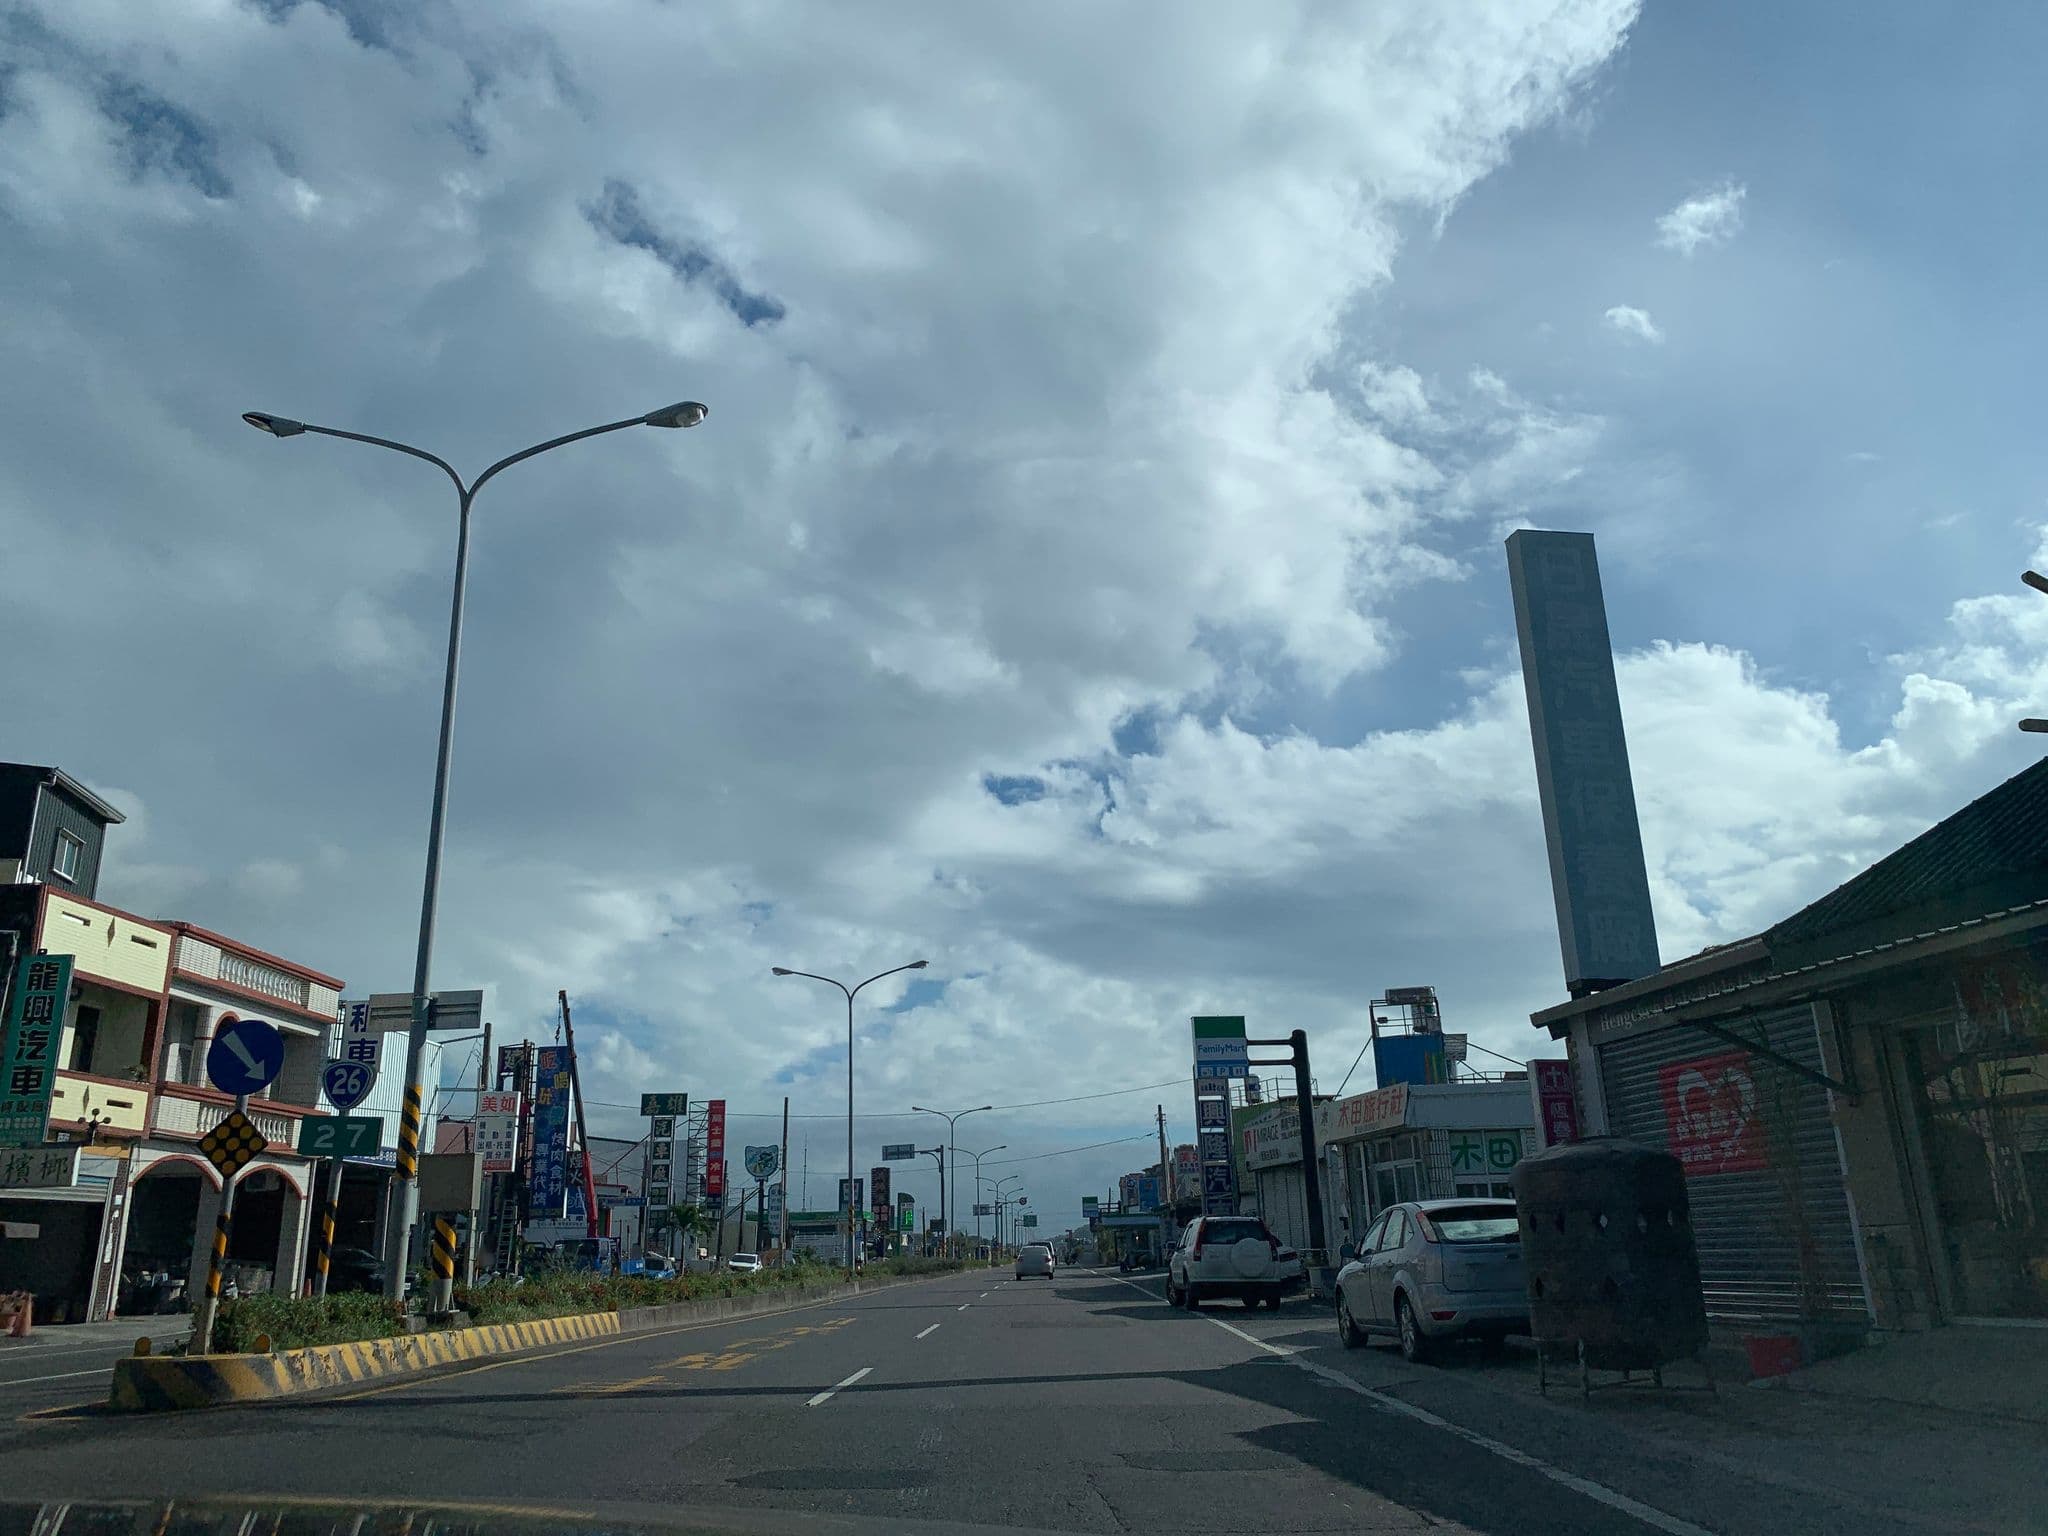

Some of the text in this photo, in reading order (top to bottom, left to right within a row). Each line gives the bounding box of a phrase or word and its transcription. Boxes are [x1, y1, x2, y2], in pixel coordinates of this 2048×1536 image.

[1198, 1044, 1246, 1055] FamilyMart
[332, 1067, 361, 1095] 26
[1450, 1135, 1518, 1169] 木田
